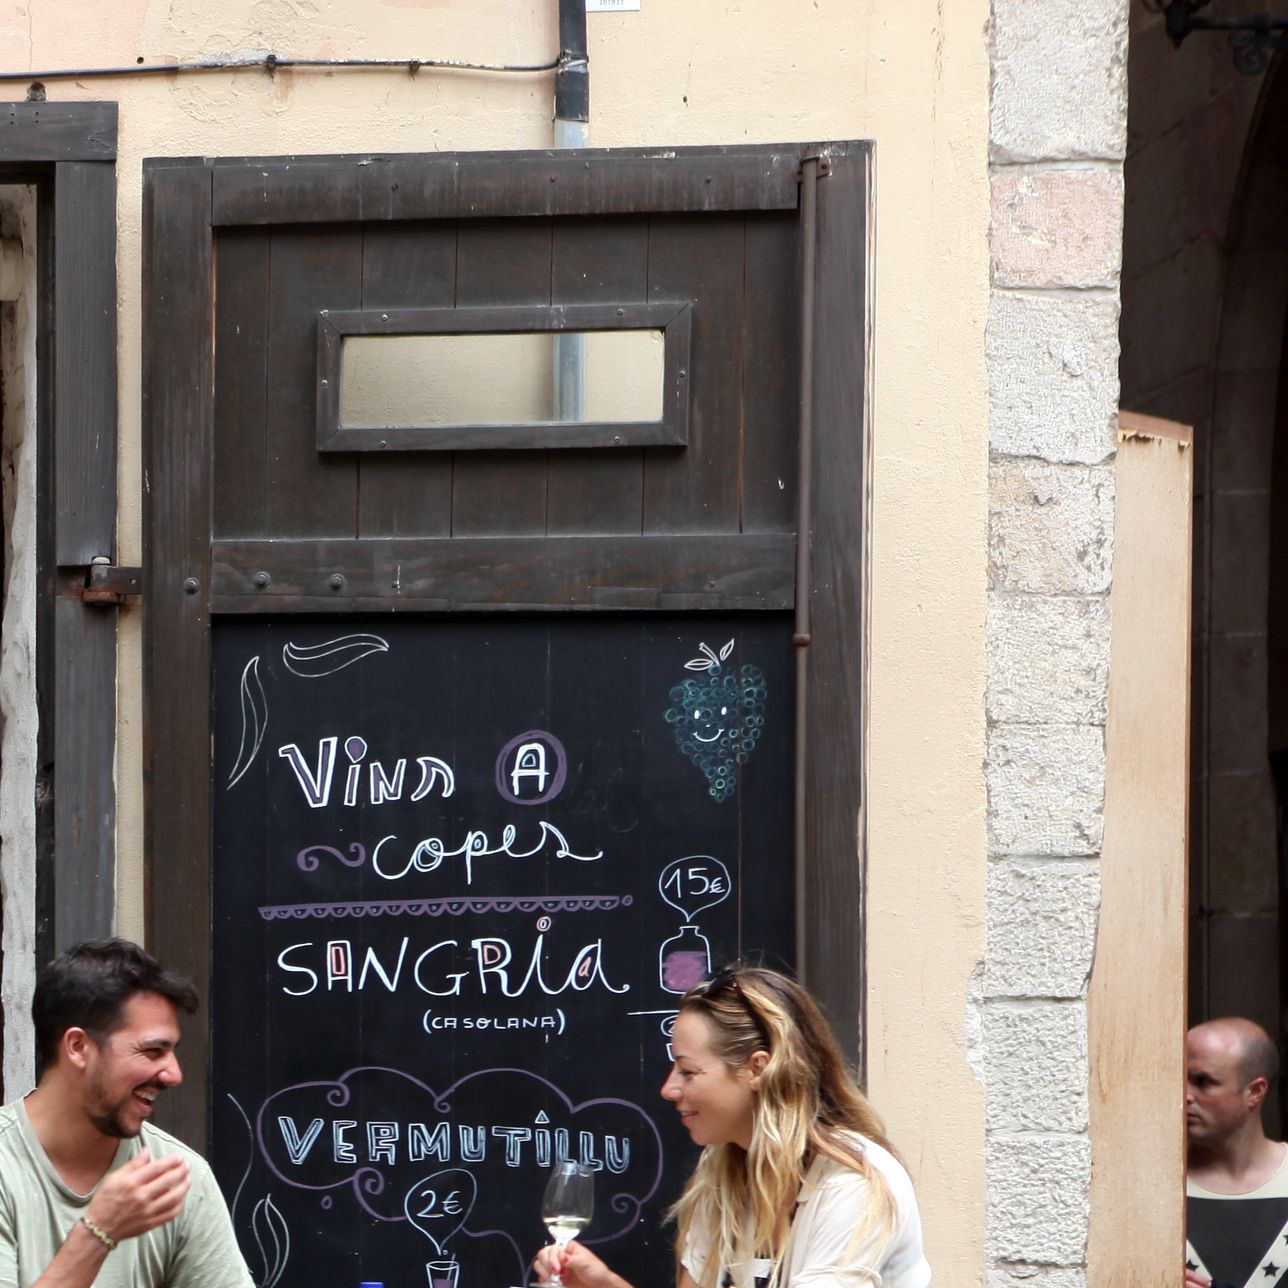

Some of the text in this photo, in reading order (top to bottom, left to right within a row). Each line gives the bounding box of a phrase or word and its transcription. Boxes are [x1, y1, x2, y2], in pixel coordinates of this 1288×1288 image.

[511, 743, 549, 796] A
[372, 820, 604, 885] copes
[423, 1008, 566, 1035] (CASOLANA)
[417, 1189, 463, 1217] 2€
